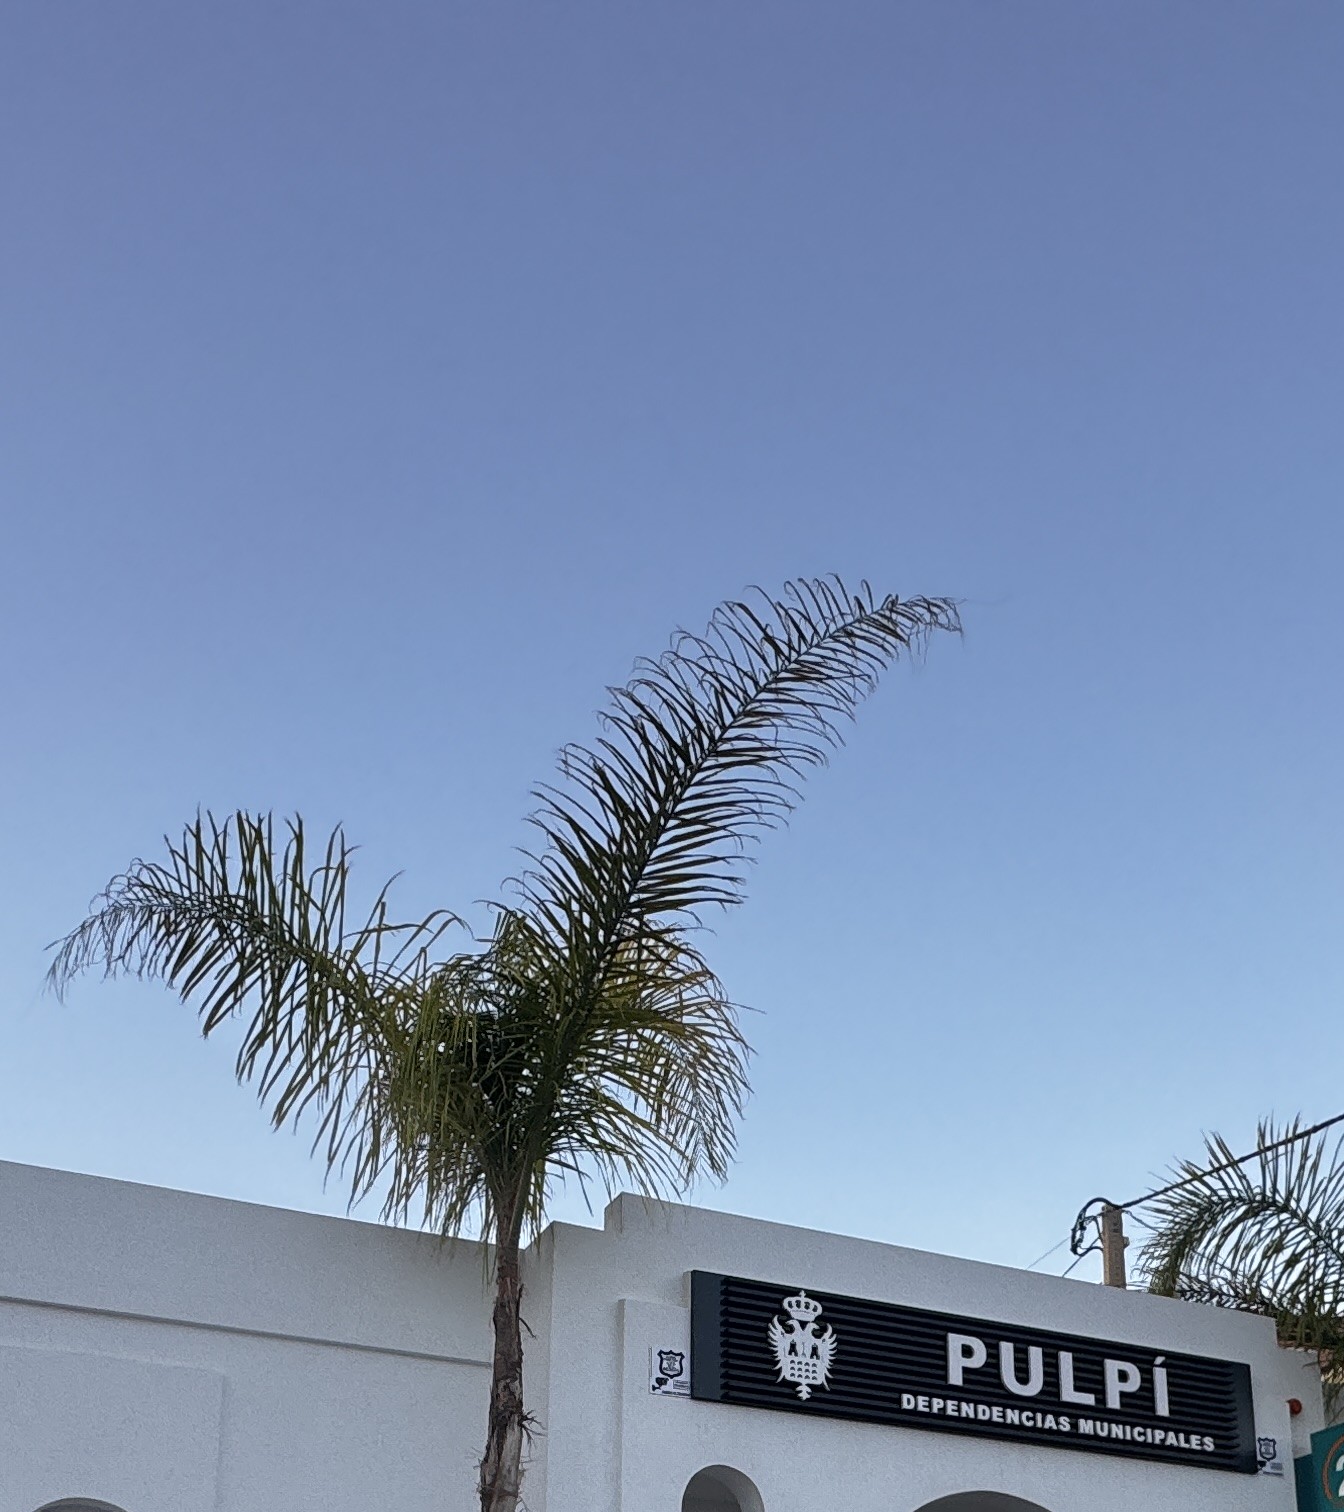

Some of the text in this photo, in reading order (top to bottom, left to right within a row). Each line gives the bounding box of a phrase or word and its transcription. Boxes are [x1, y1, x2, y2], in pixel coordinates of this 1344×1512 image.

[946, 1332, 1170, 1417] PULPÍ
[901, 1393, 1215, 1452] DEPENDENCIAS MUNICIPALES
